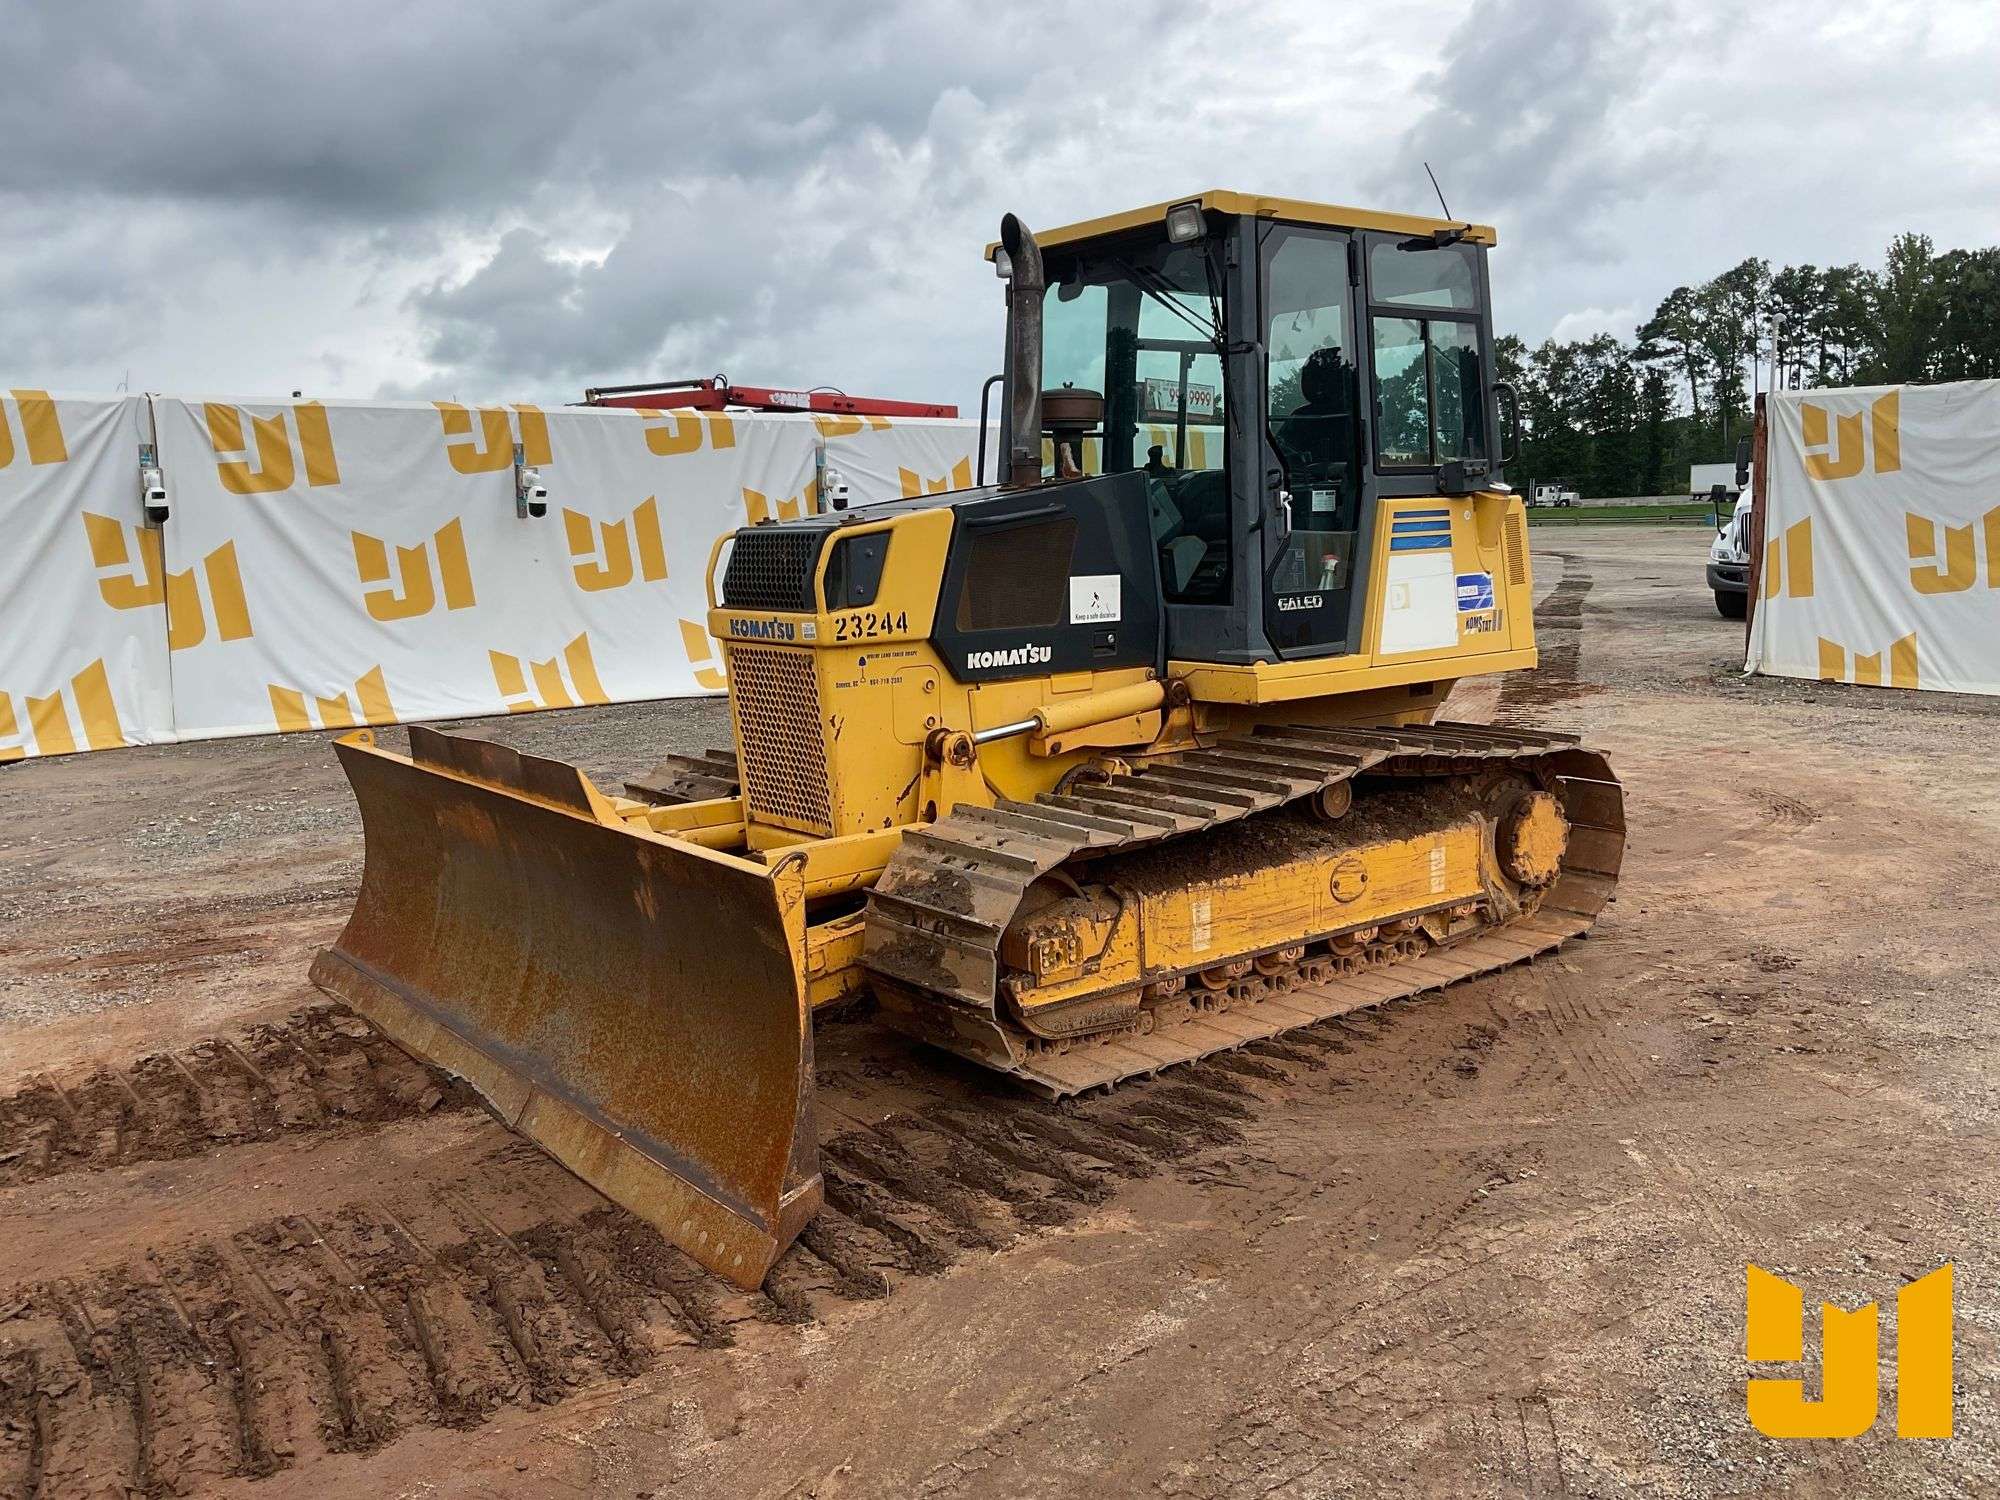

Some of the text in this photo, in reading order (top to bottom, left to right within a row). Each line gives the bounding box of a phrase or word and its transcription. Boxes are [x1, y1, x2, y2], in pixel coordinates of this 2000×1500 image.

[1278, 595, 1323, 611] GALEO
[730, 617, 795, 641] KOMATSU
[834, 611, 909, 642] 23244
[967, 643, 1052, 669] KOMATSU
